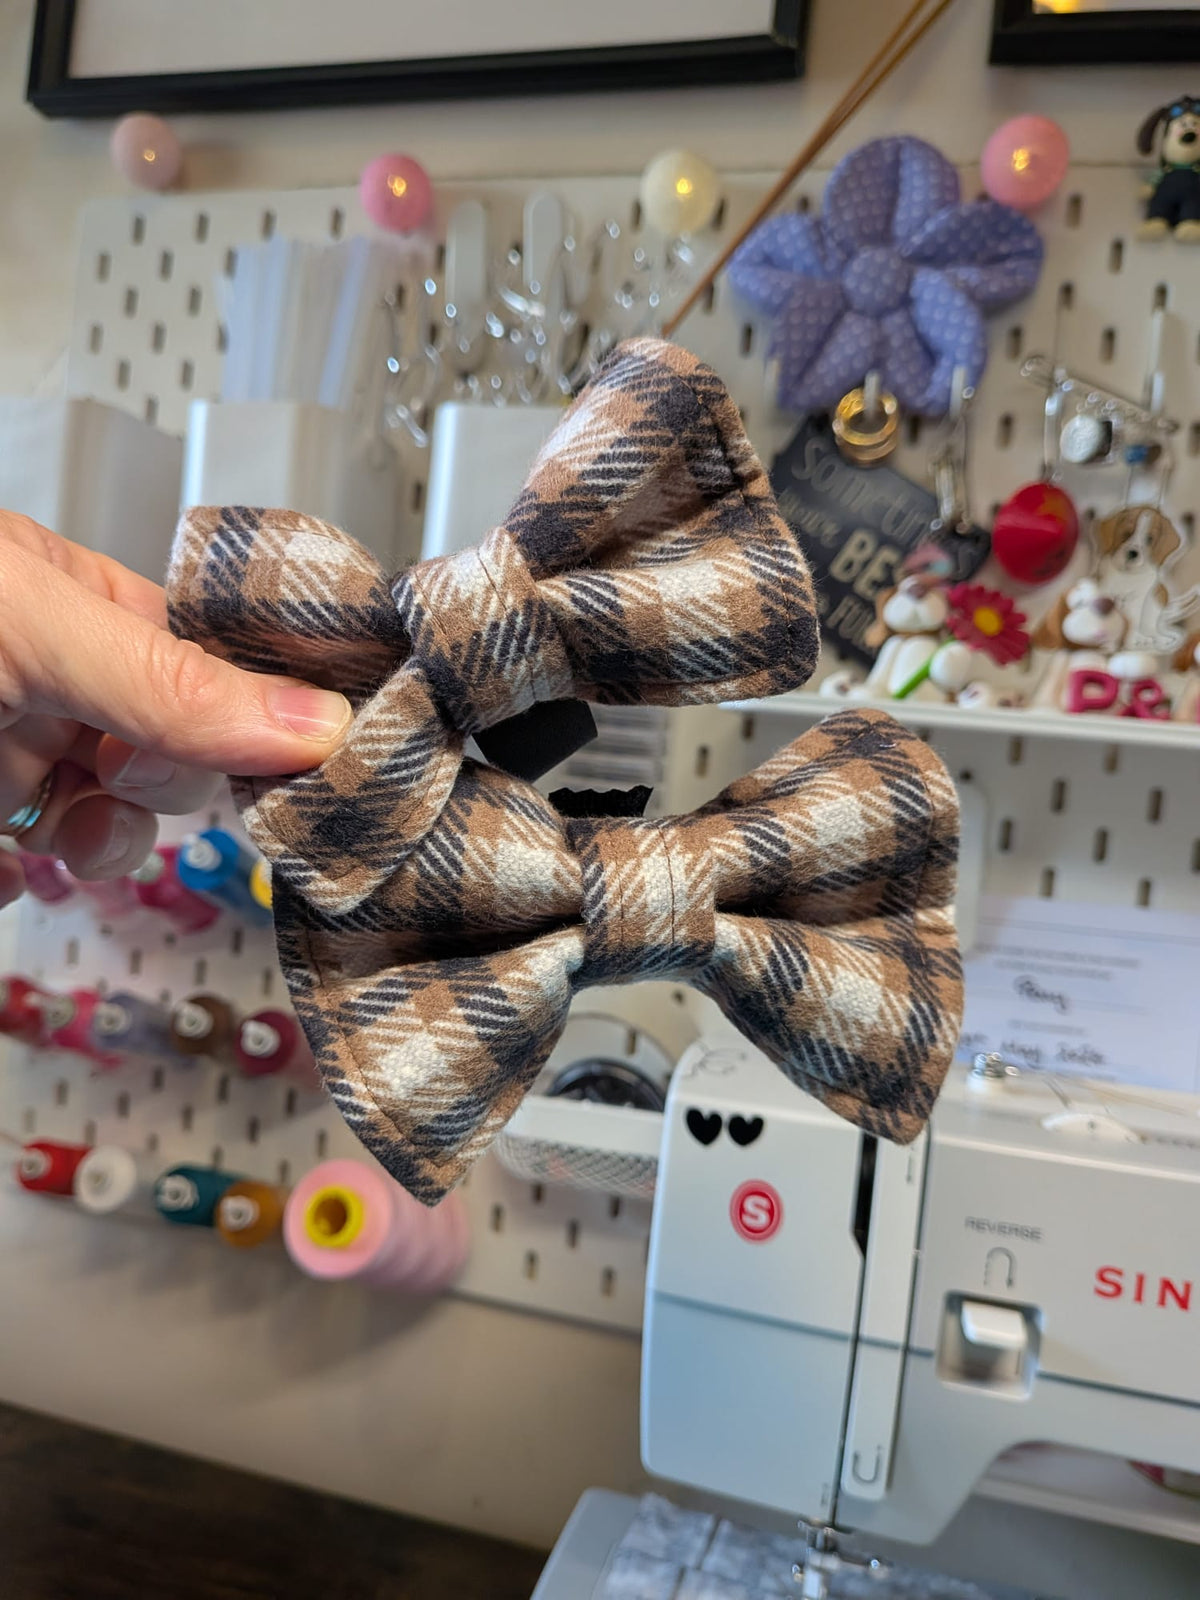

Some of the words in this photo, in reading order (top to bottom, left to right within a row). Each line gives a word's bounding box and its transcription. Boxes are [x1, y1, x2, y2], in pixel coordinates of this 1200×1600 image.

[830, 529, 902, 598] BE
[964, 1215, 1045, 1243] REVERSE
[1093, 1264, 1192, 1312] SIN
